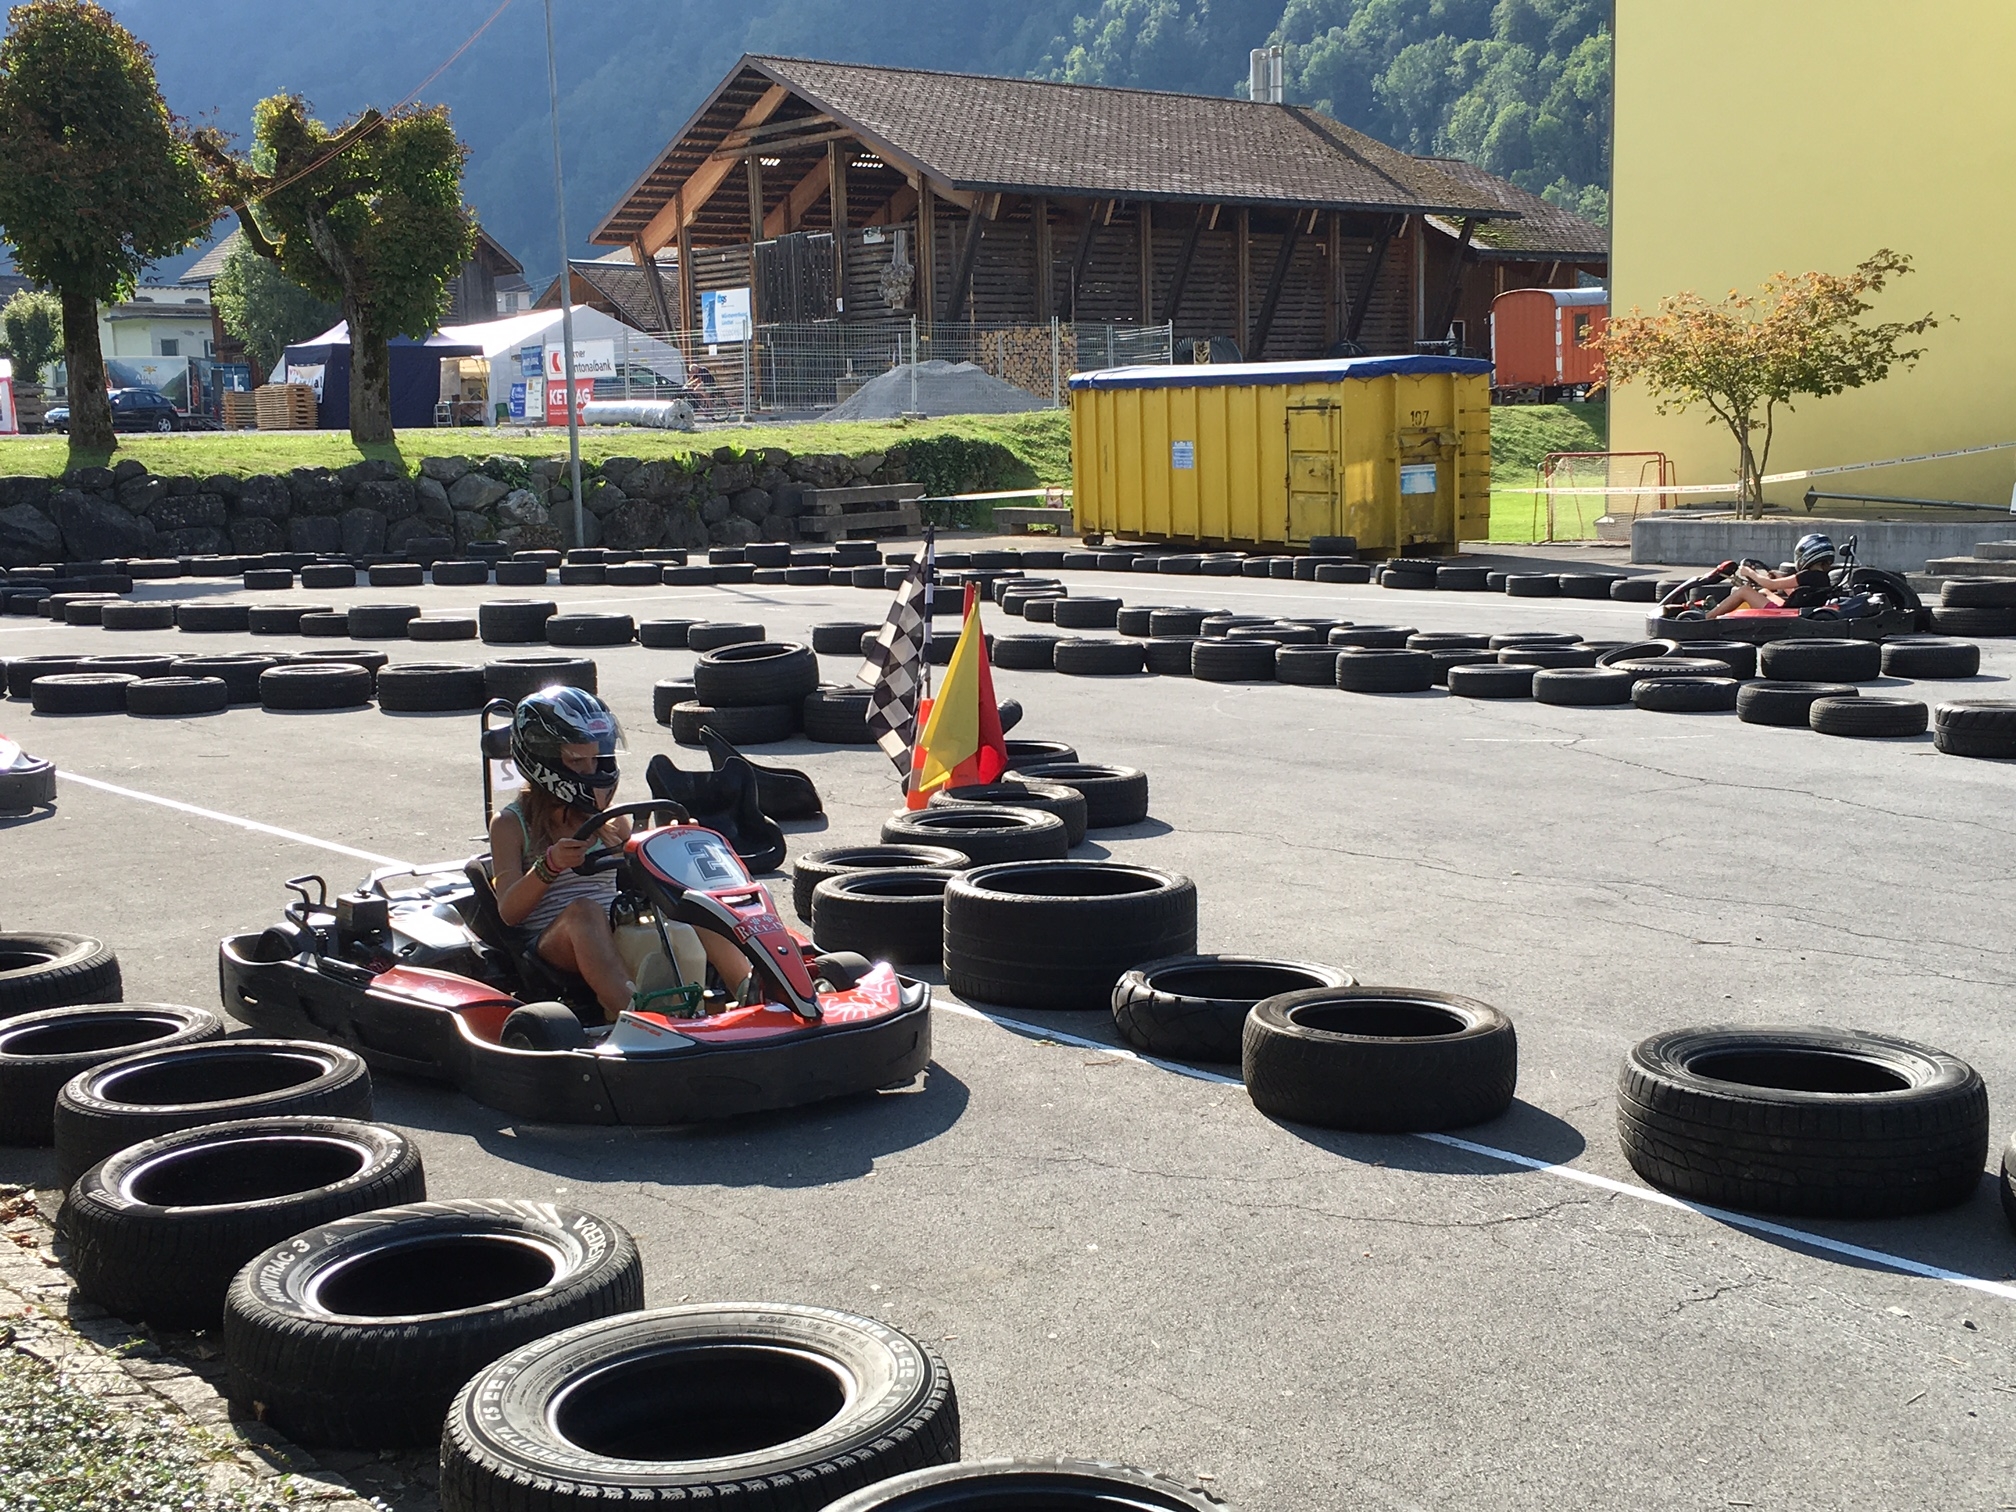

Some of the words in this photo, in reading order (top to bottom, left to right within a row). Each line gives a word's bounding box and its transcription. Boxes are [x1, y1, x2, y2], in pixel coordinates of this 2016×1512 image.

[574, 358, 612, 373] ntonalbank
[1410, 410, 1430, 427] 107
[259, 1250, 297, 1304] SNOWTRAC
